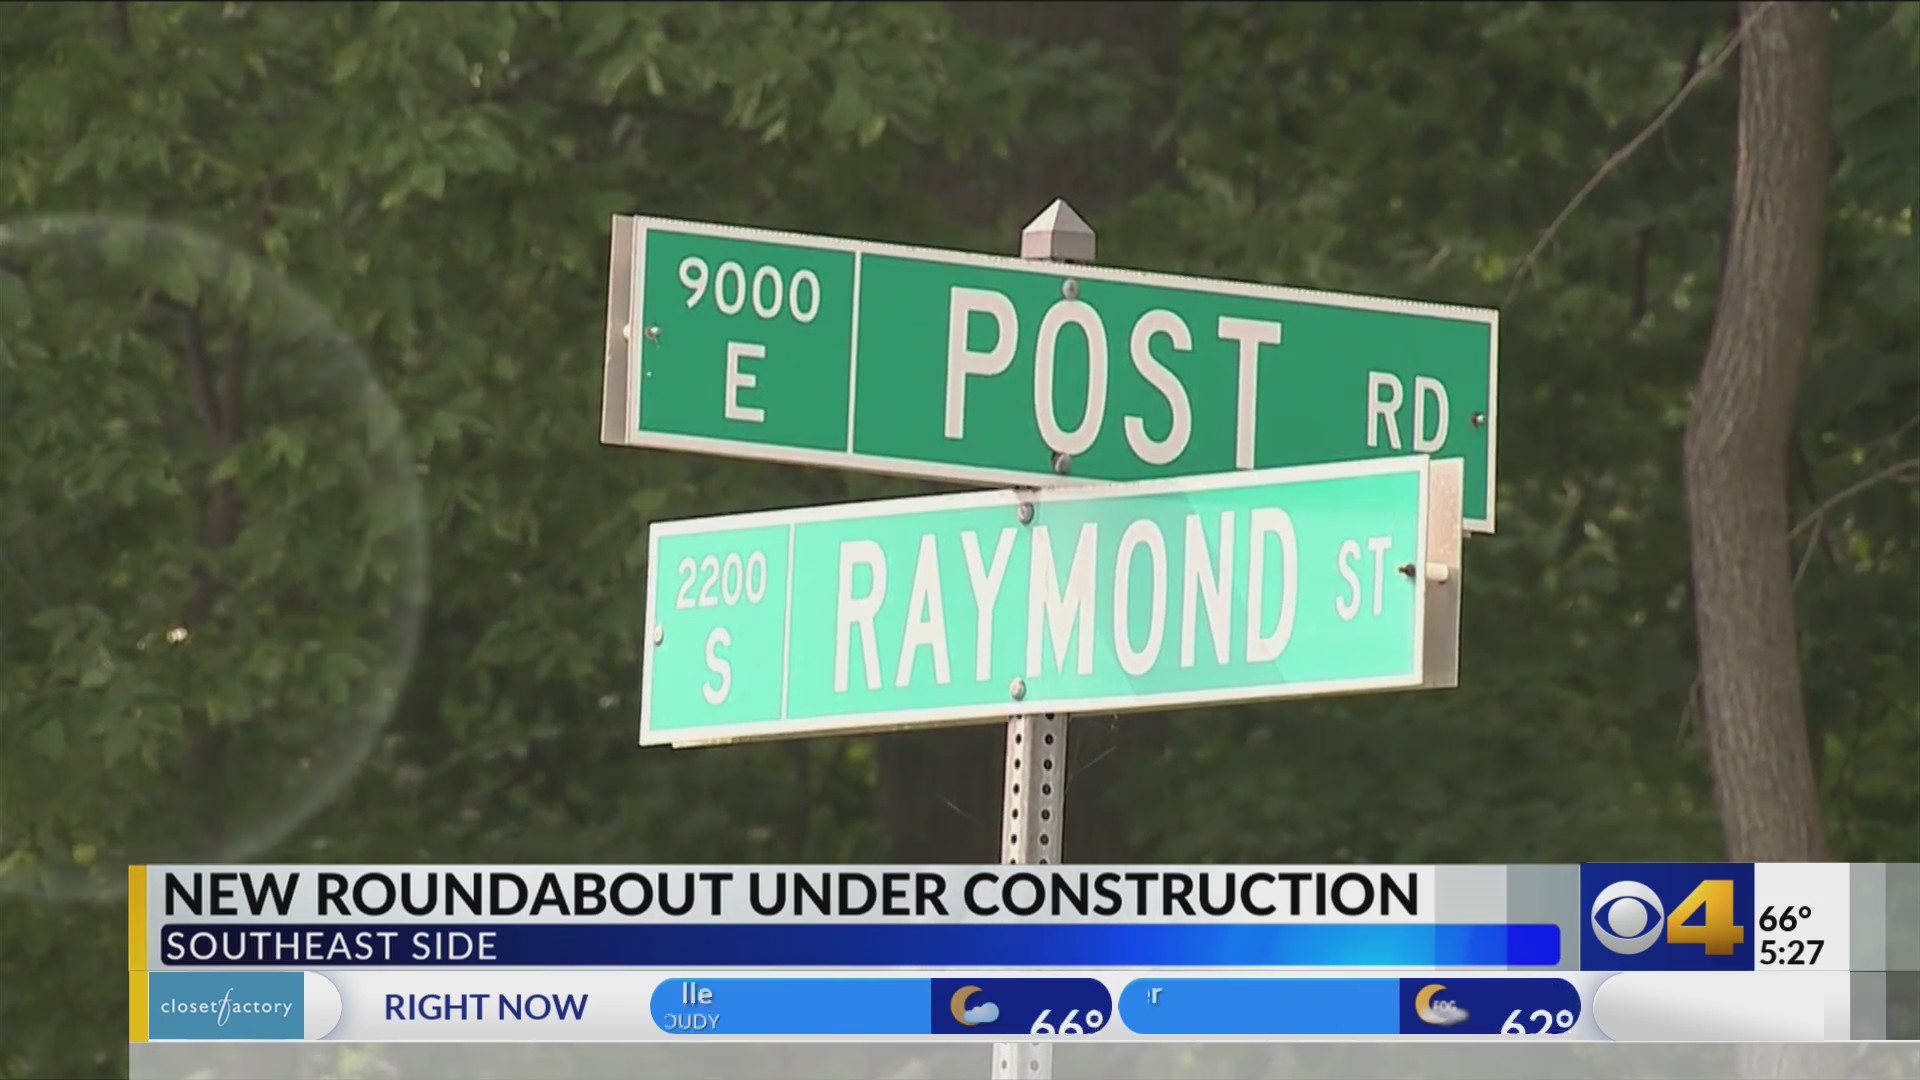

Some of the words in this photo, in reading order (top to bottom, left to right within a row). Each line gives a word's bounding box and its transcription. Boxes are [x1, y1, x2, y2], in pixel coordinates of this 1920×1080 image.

[678, 256, 821, 324] 9000
[724, 341, 766, 423] E
[944, 286, 1282, 471] POST
[1367, 371, 1450, 453] RD
[675, 550, 768, 610] 2200
[833, 507, 1298, 693] RAYMOND
[1336, 536, 1392, 622] ST
[702, 627, 732, 706] S
